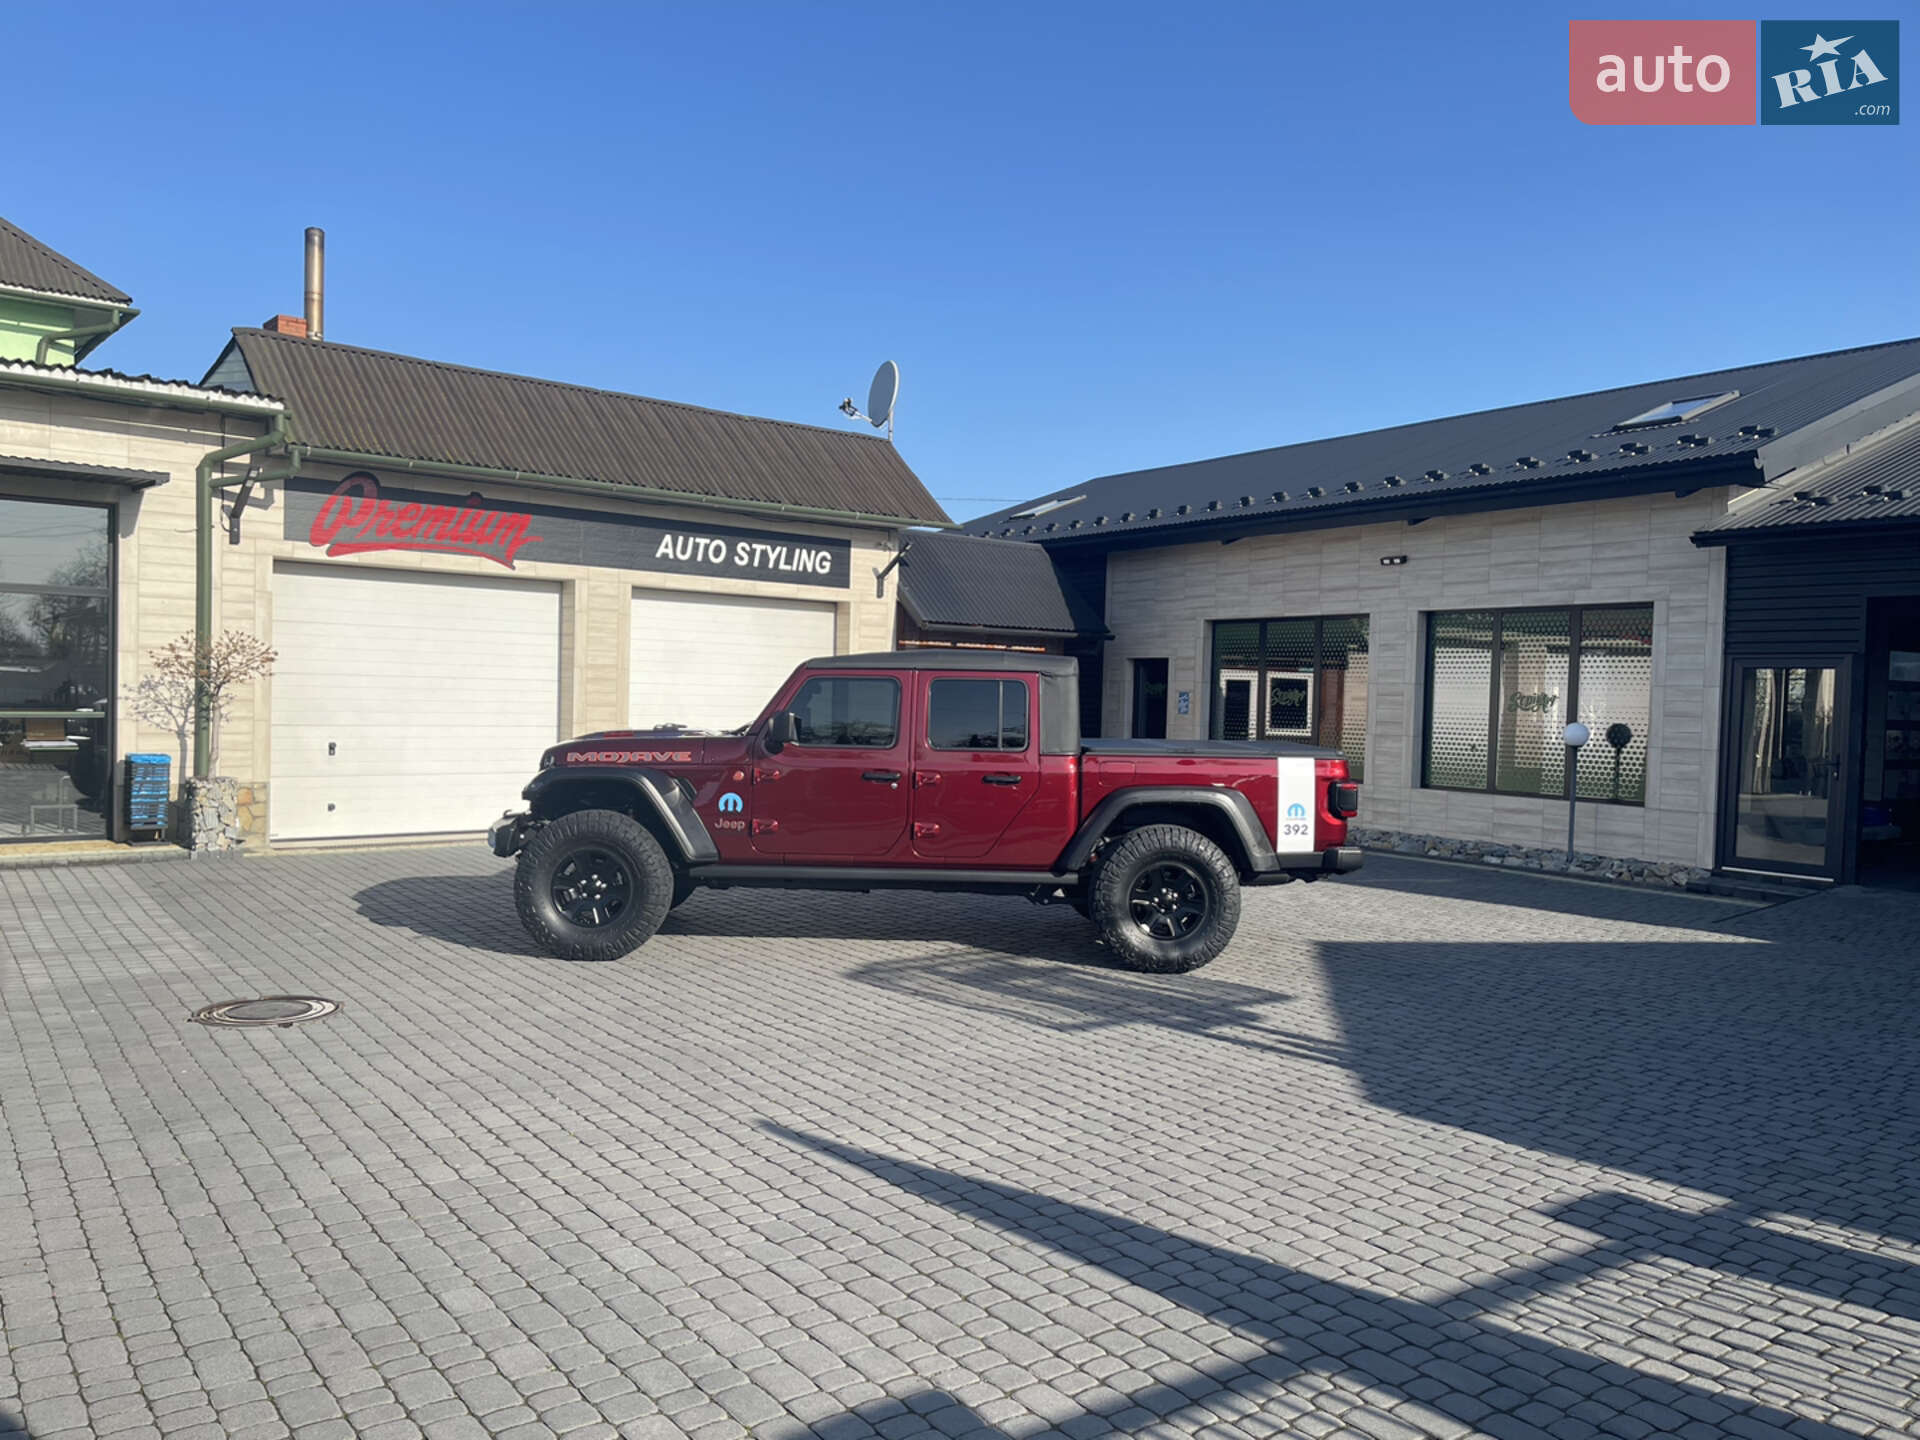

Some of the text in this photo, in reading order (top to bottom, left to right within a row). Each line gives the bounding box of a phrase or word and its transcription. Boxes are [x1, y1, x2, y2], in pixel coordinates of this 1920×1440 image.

[310, 472, 544, 569] Premium
[655, 534, 832, 575] AUTO STYLING
[566, 751, 692, 764] MOJAVE
[714, 817, 746, 831] Jeep
[1283, 823, 1309, 836] 392
